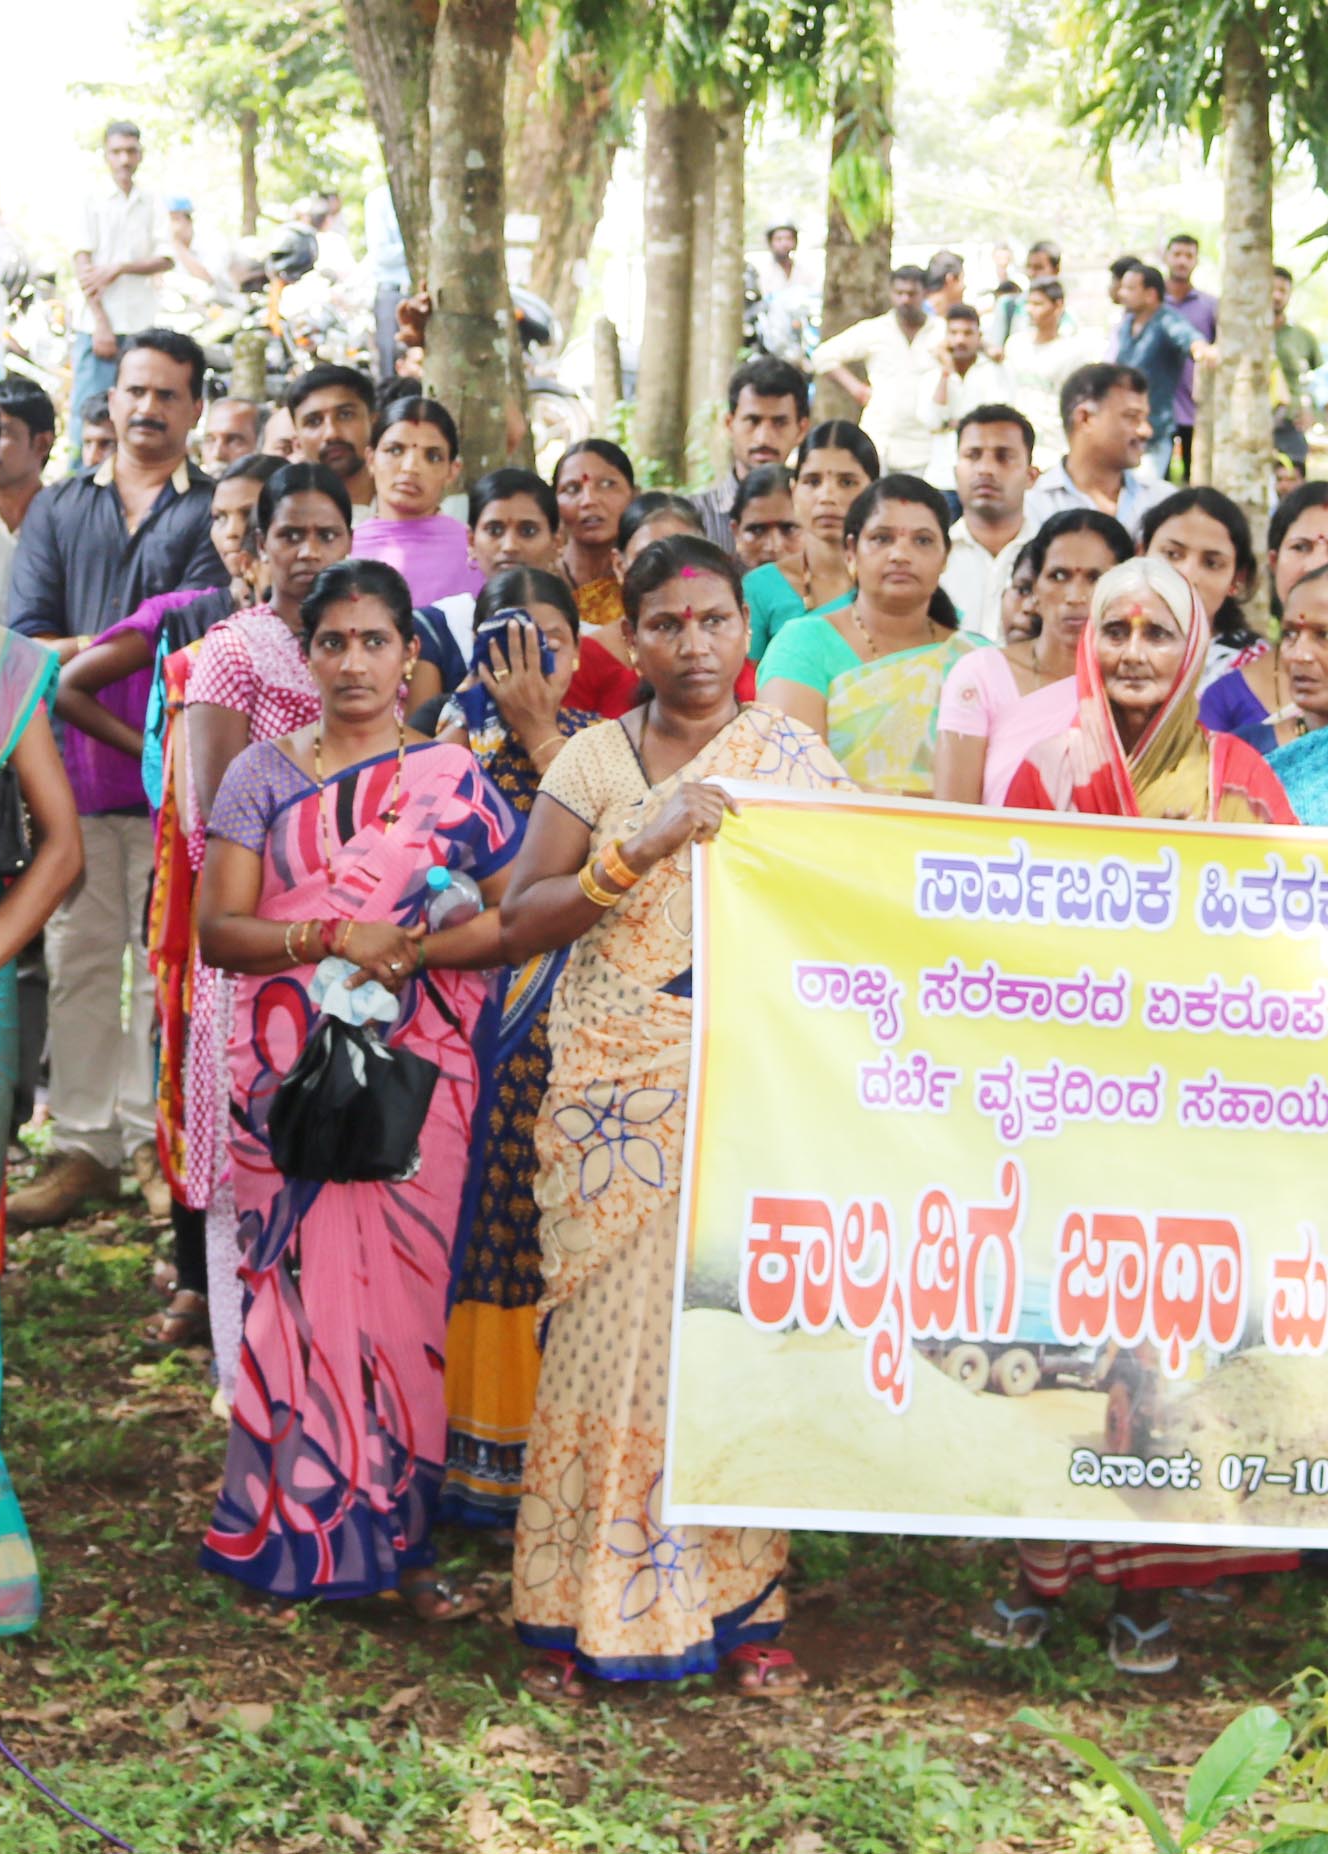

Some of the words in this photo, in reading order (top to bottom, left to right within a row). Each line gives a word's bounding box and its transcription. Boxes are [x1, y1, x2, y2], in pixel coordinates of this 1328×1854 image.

[919, 844, 1173, 925] ಸಾರ್ವಜನಿಕ
[796, 963, 901, 1040] ರಾಜ್ಯ
[922, 963, 1126, 1022] ಸರಕಾರದ
[1147, 979, 1325, 1034] ಏಕರೂಪ
[860, 1055, 956, 1104] ದರ್ಬೆ
[979, 1061, 1160, 1139] ವೃತ್ತದಿಂದ
[746, 1160, 1022, 1407] ಕಾಲ್ನಡಿಗೆ
[1070, 1449, 1200, 1490] ದಿನಾಂಕ:
